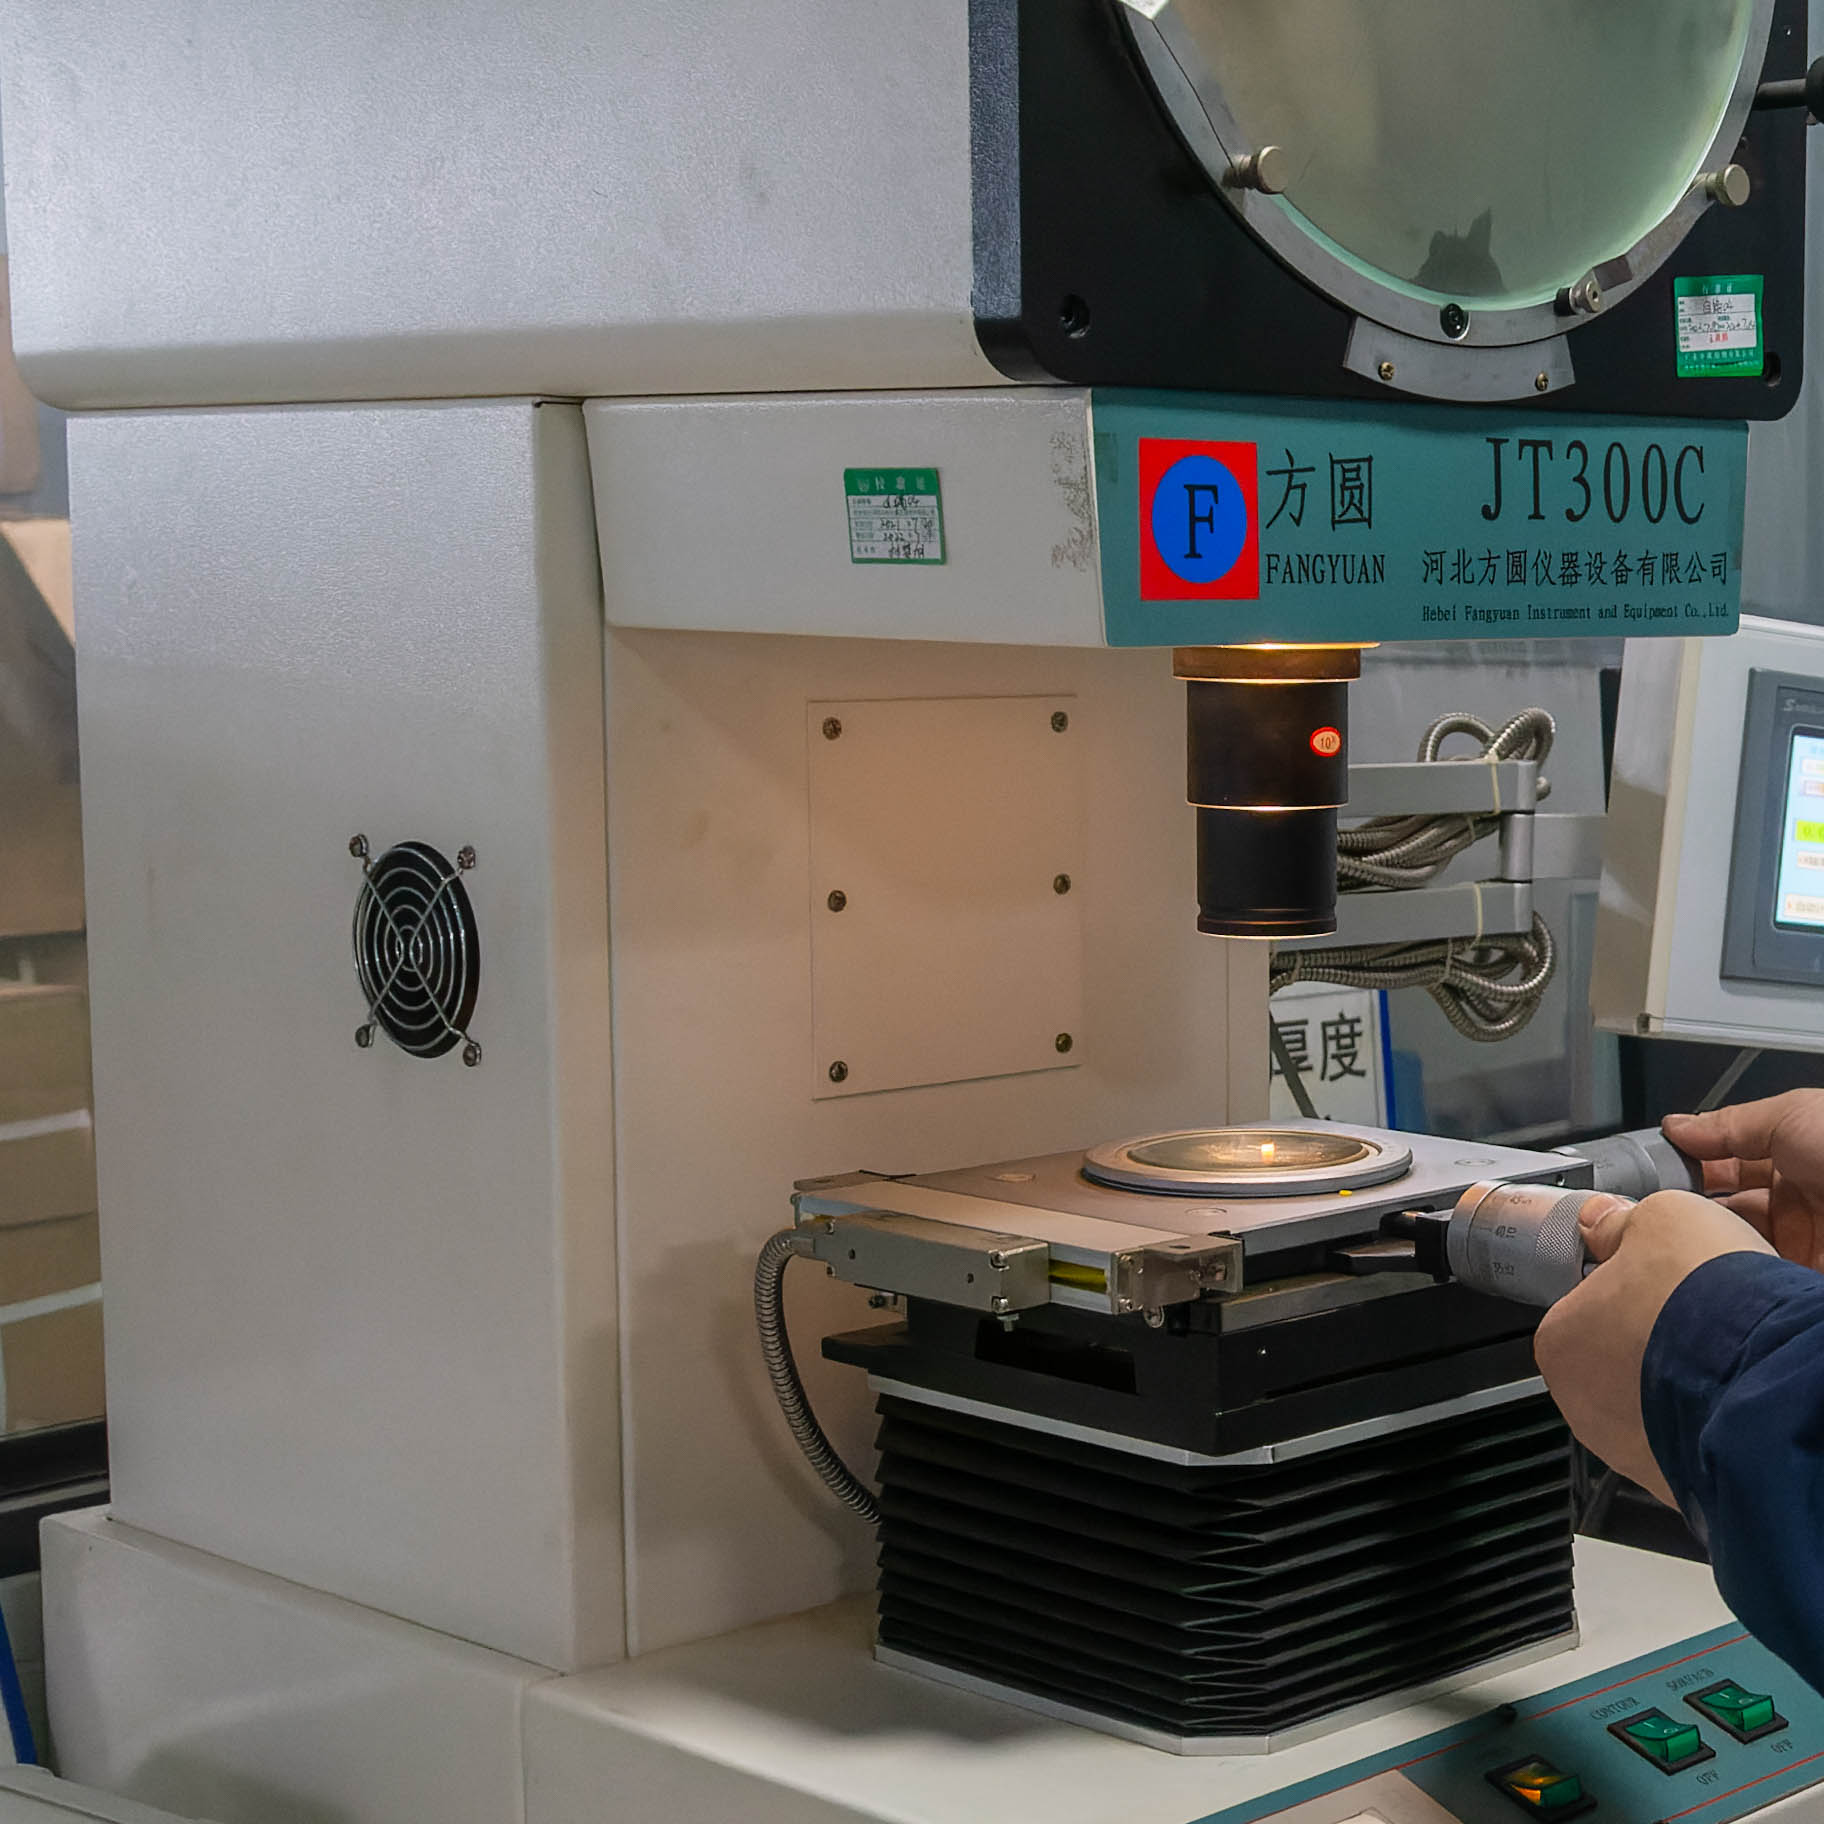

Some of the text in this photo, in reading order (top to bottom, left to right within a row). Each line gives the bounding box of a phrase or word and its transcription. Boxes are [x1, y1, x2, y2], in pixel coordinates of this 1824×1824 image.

[1265, 448, 1375, 531] 方圆
[1481, 436, 1706, 525] JT300C
[1184, 484, 1219, 559] F
[1266, 553, 1385, 585] FANGYUAN
[1422, 547, 1728, 588] 河北方圆仪器设备有限公司
[1422, 605, 1457, 622] Hebei
[1465, 605, 1520, 624] Fangyuan
[1527, 604, 1591, 621] Instrument
[1599, 604, 1618, 620] and
[1623, 603, 1678, 622] Equipment
[1591, 1696, 1641, 1721] CONTOUR
